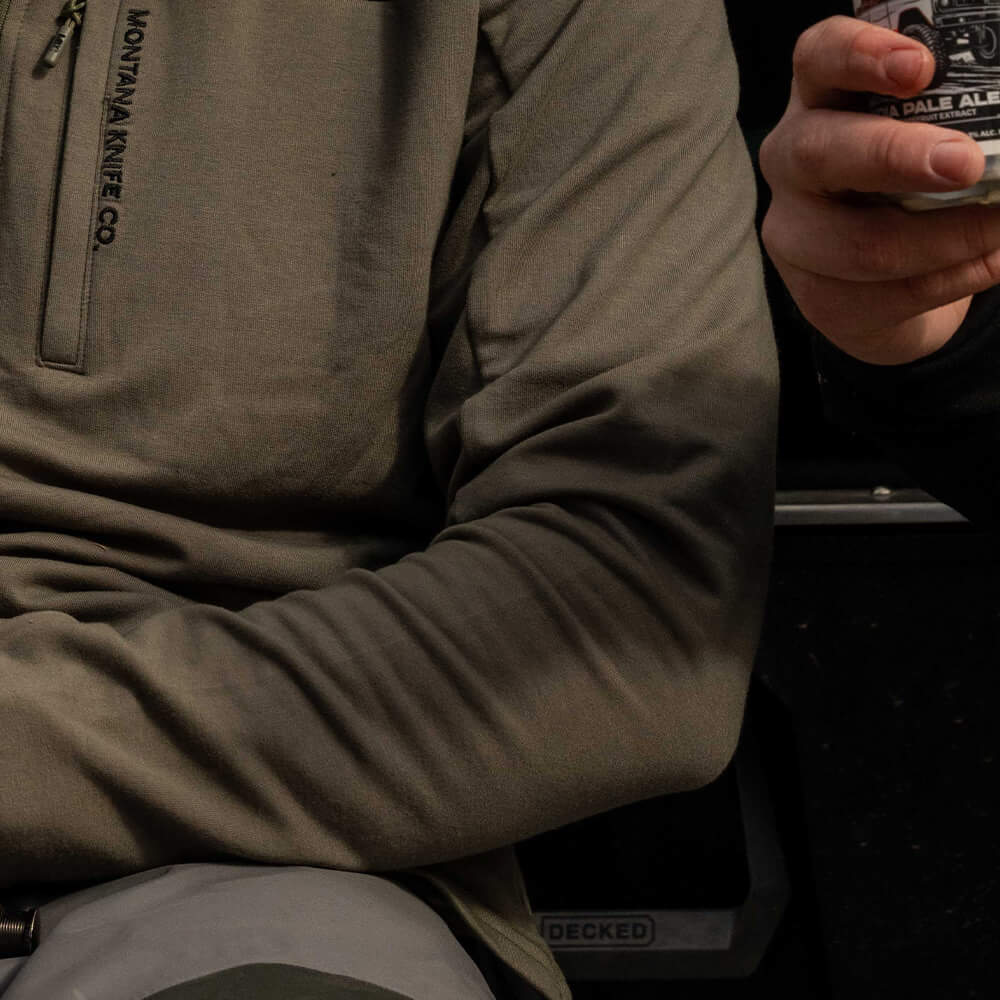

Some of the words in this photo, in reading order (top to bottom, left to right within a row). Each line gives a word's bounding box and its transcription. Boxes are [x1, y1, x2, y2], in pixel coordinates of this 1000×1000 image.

[108, 8, 150, 124] MONTANA
[903, 96, 953, 115] PALE
[959, 91, 1000, 108] ALE
[940, 108, 976, 120] EXTRACT
[102, 129, 128, 199] KNIFE
[550, 924, 647, 939] DECKED
